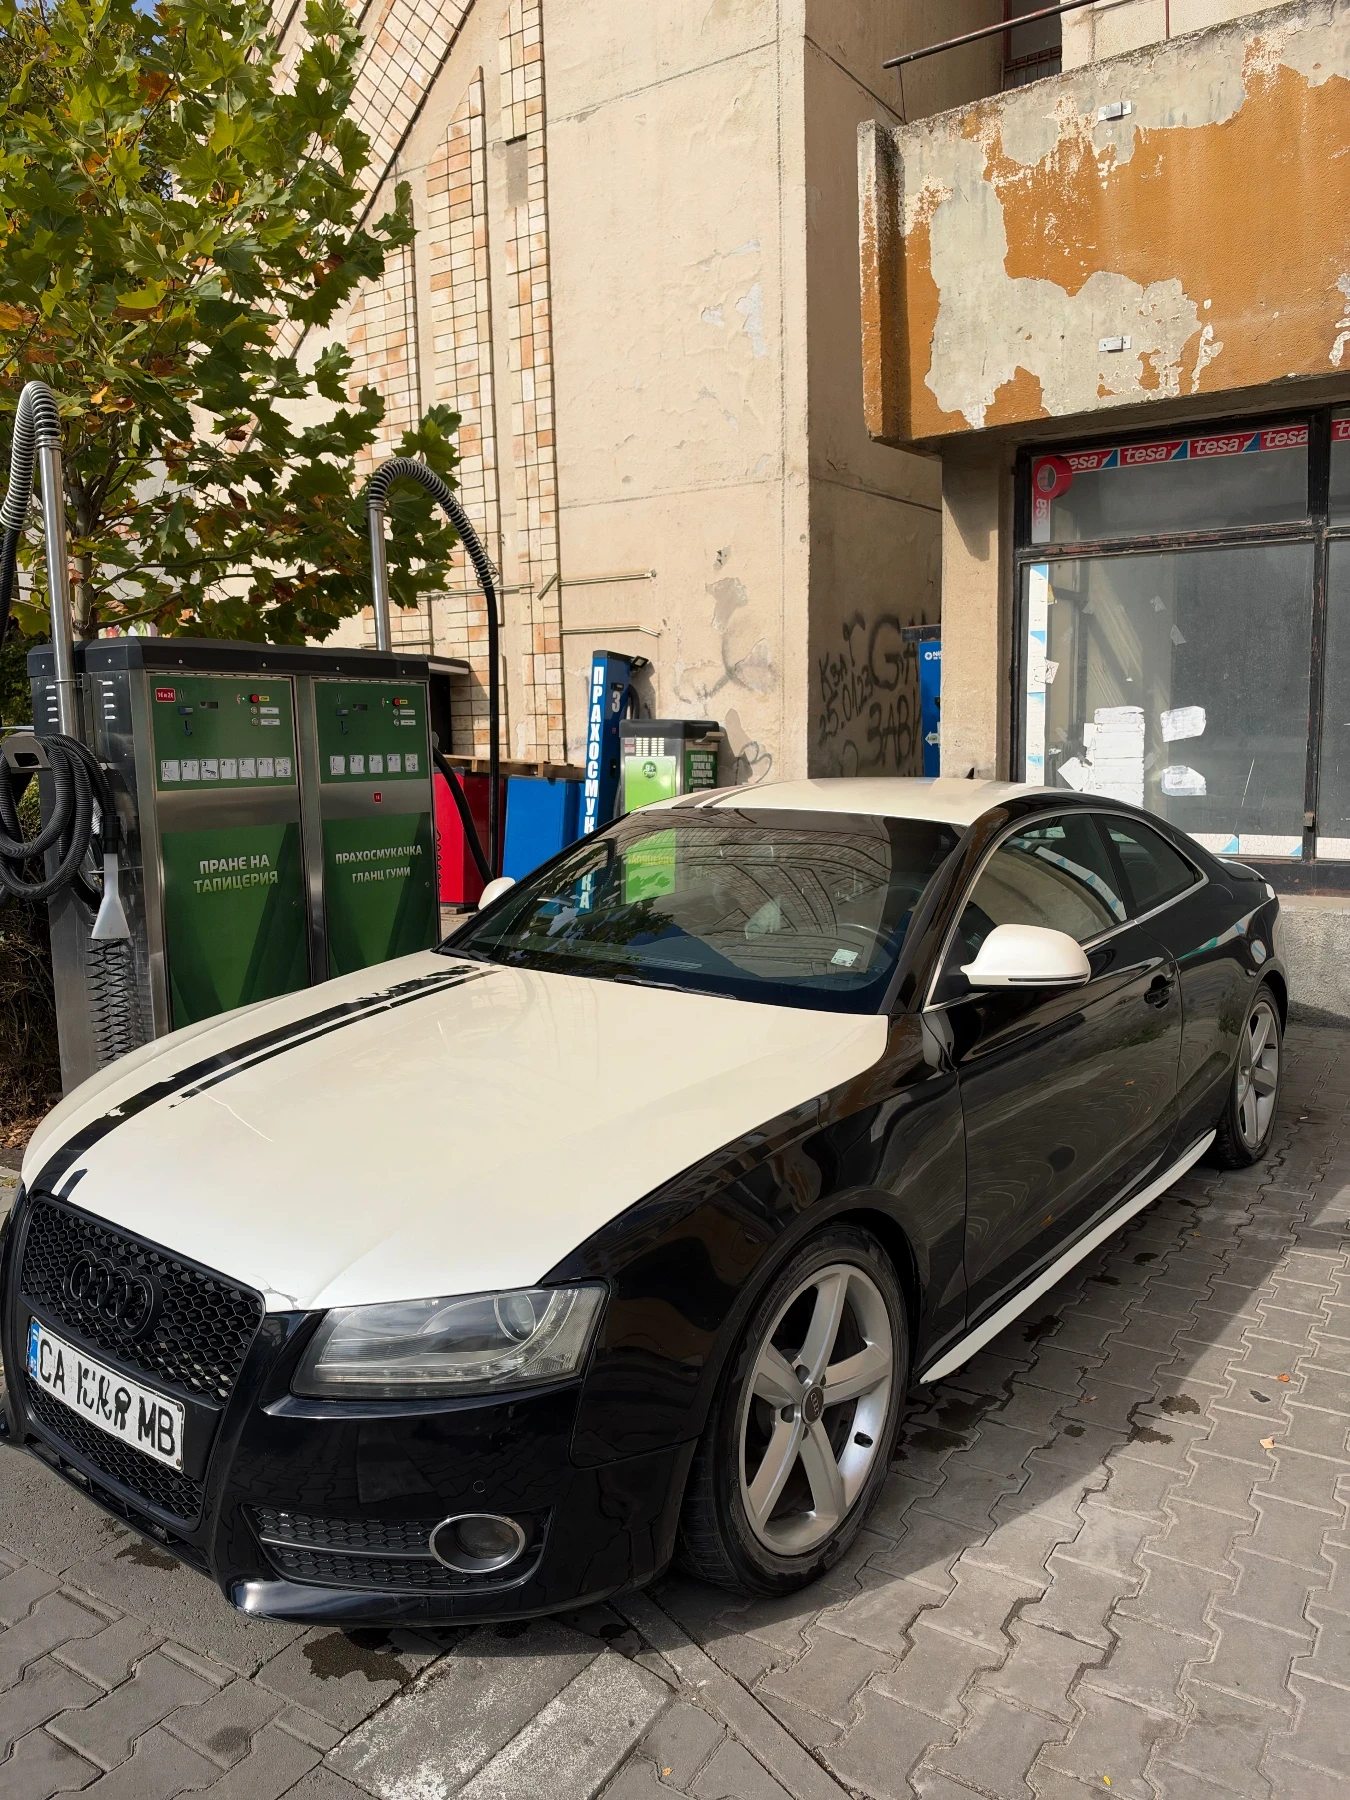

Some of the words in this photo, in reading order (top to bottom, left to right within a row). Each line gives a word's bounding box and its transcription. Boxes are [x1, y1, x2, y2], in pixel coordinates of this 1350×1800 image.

[1124, 446, 1167, 463] tesa
[1194, 438, 1239, 455] tesa
[1067, 454, 1098, 470] esa
[611, 691, 621, 713] 3
[199, 856, 248, 875] ПРАНЕ
[250, 854, 270, 869] НА
[335, 845, 423, 865] ПРАХОСМУКАЧКА
[194, 870, 278, 893] ТАПИЦЕРИЯ
[352, 868, 385, 884] ГЛАНЦ
[386, 866, 411, 880] ГУМИ
[39, 1338, 66, 1395] CA
[137, 1395, 176, 1457] MB
